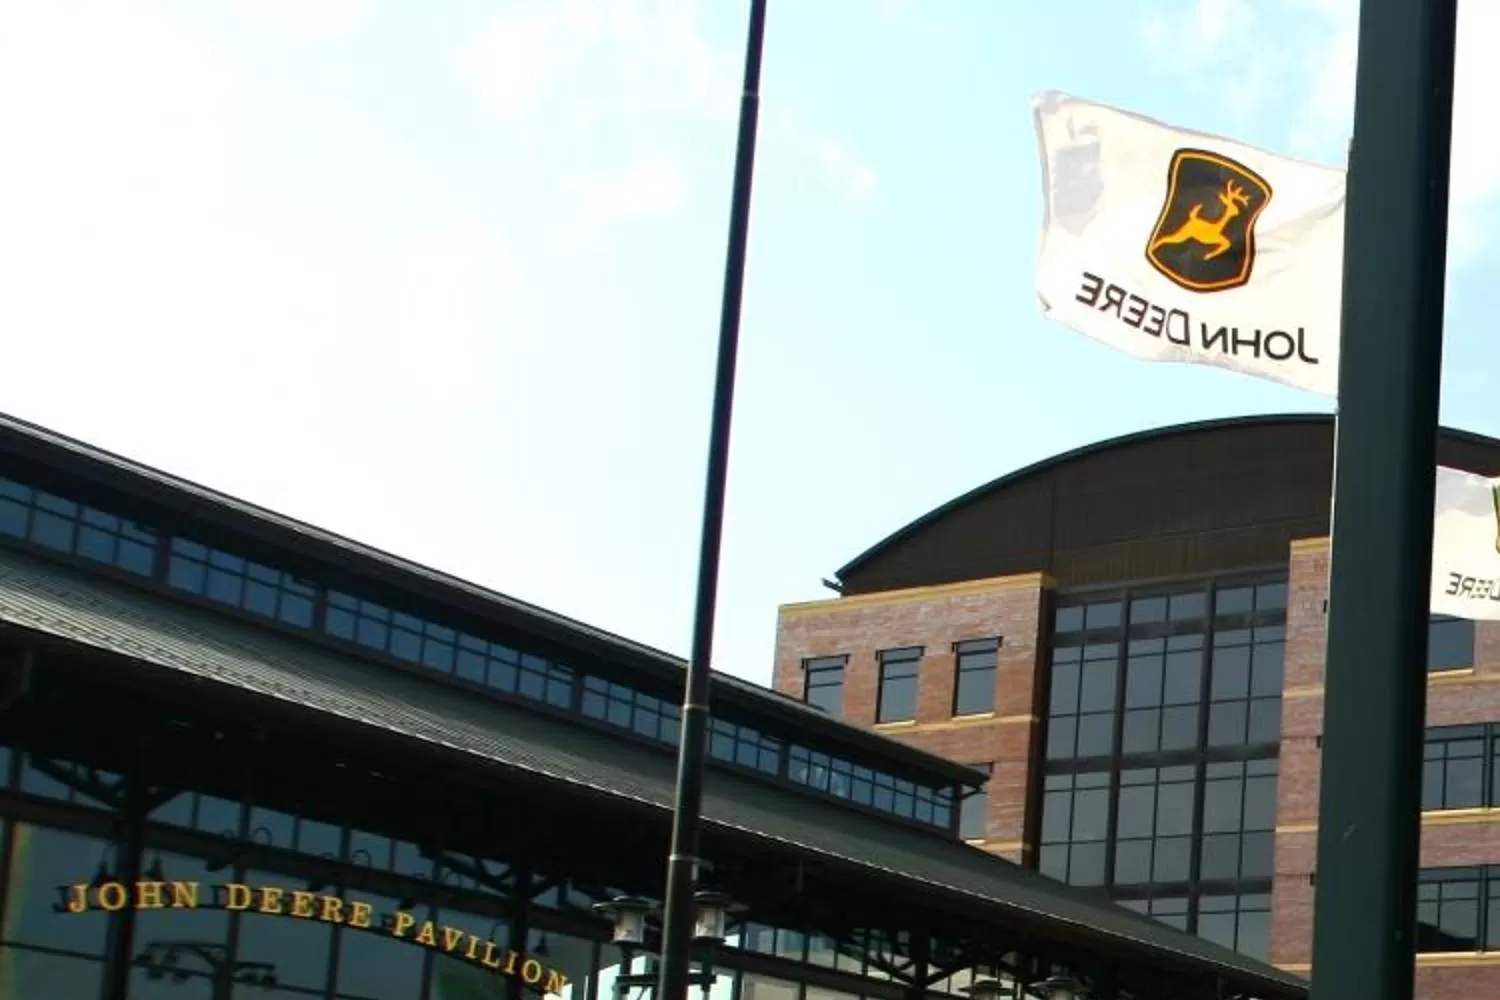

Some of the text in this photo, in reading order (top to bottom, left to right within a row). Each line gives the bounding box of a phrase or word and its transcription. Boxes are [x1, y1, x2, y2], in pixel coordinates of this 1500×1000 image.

[69, 881, 568, 995] JOHN DEERE PAVILION
